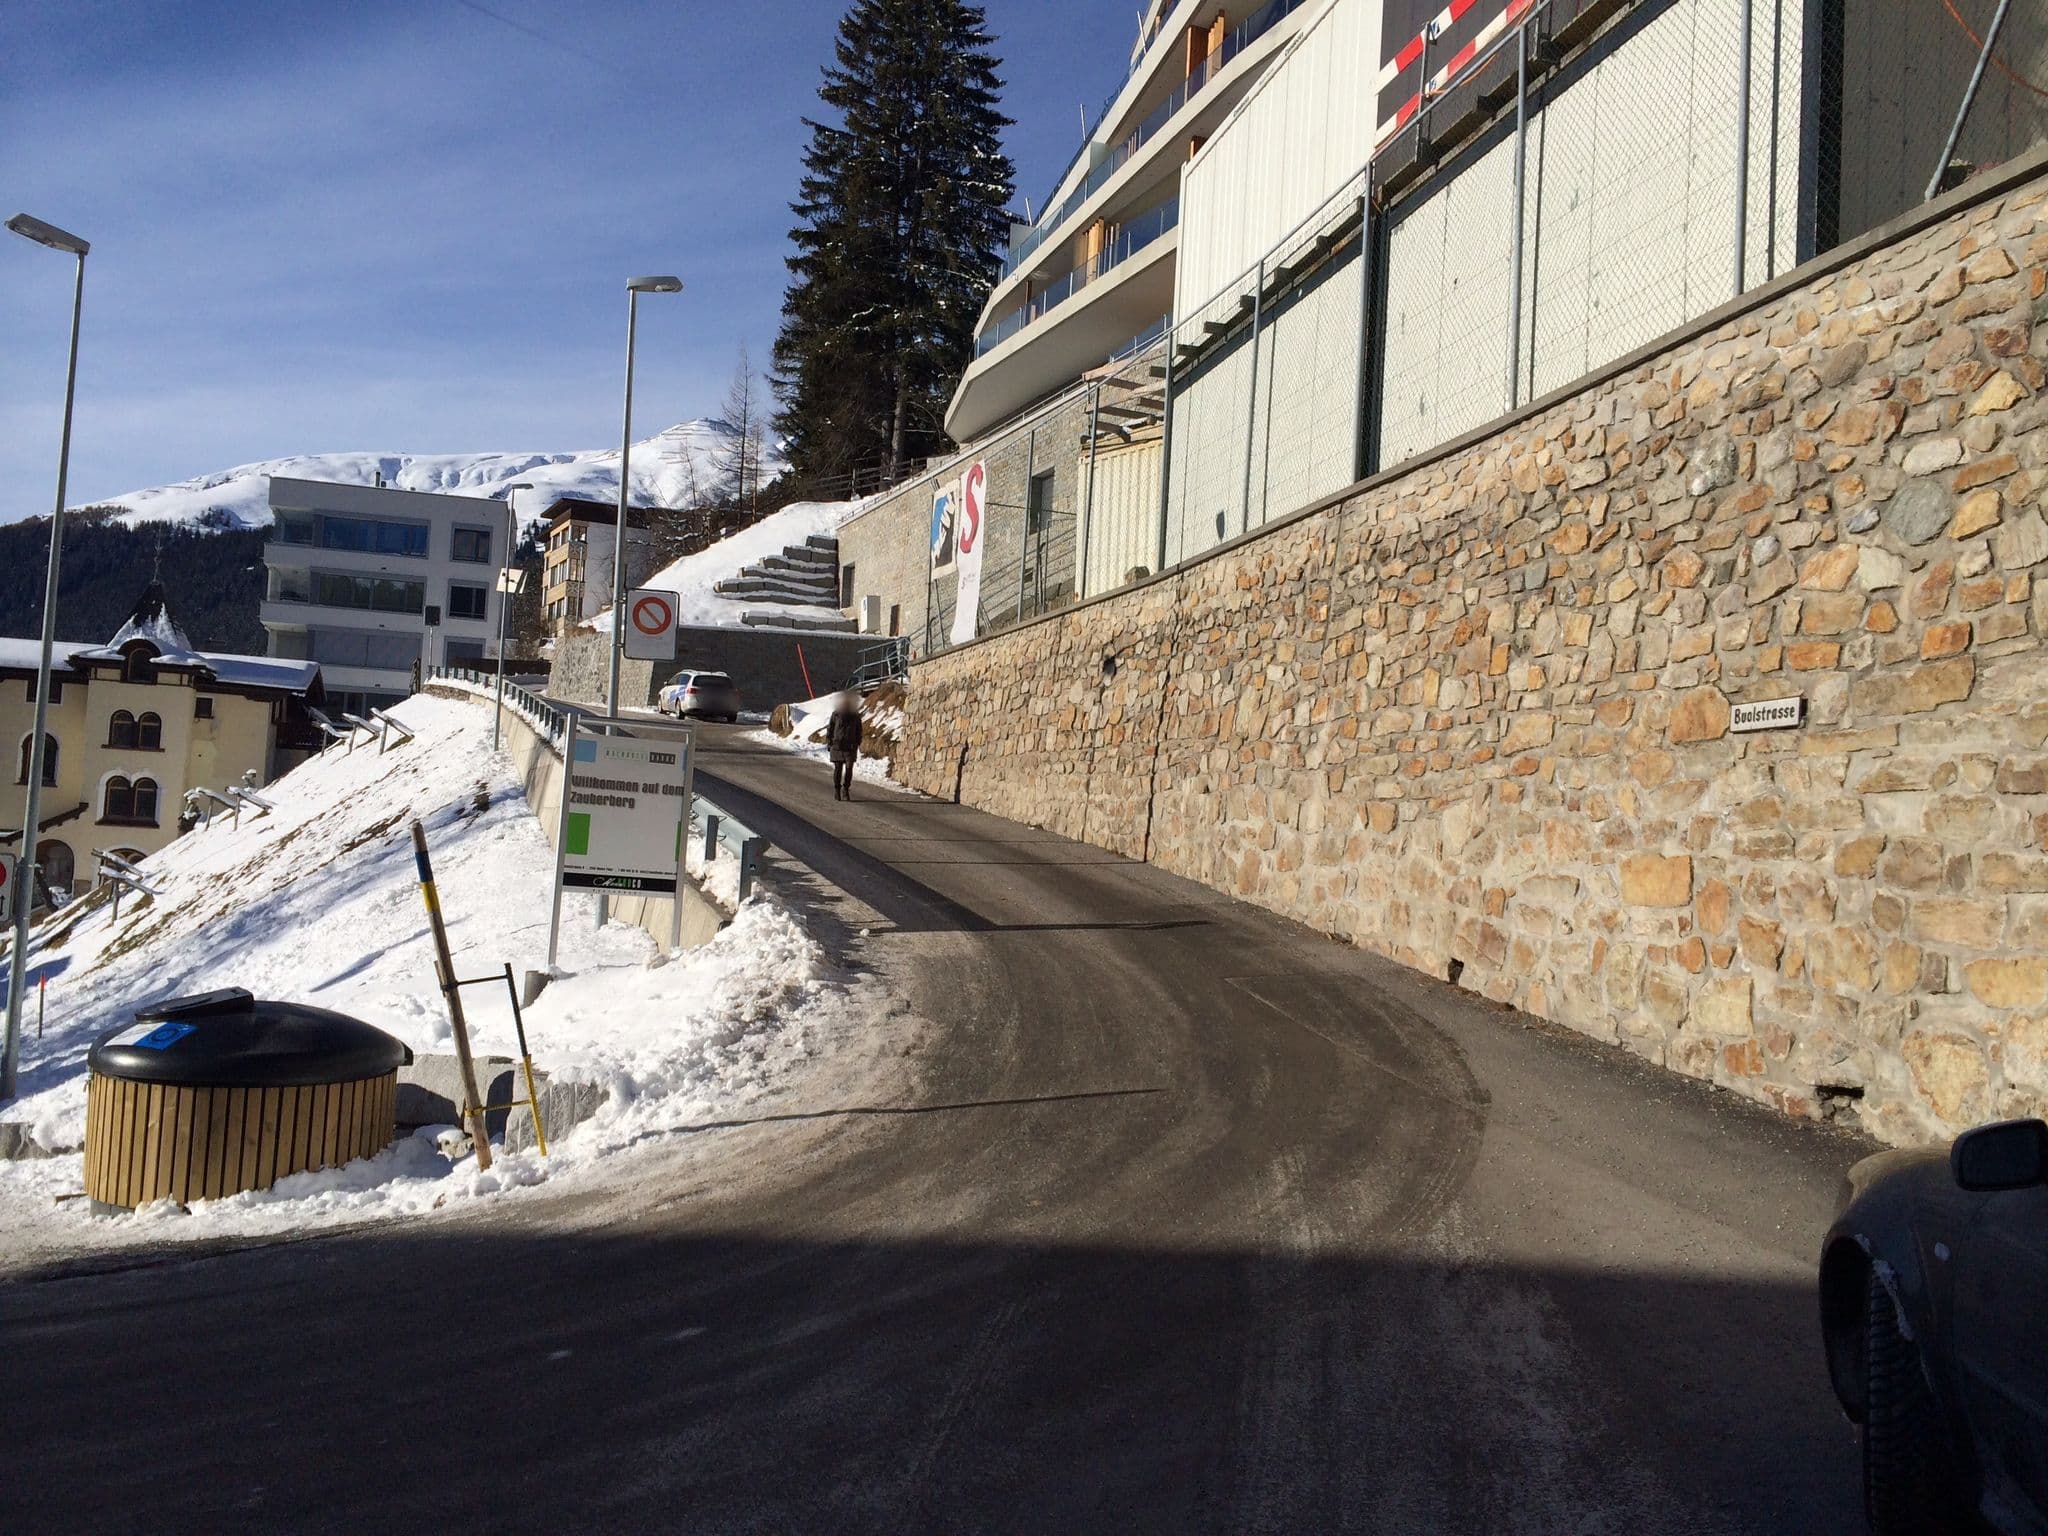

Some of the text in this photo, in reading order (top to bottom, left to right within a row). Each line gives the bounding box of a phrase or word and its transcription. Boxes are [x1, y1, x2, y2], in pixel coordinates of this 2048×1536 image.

[1734, 706, 1795, 724] Buolstrasse
[571, 775, 685, 796] Willkommen auf dem
[569, 791, 635, 808] Zauberberg
